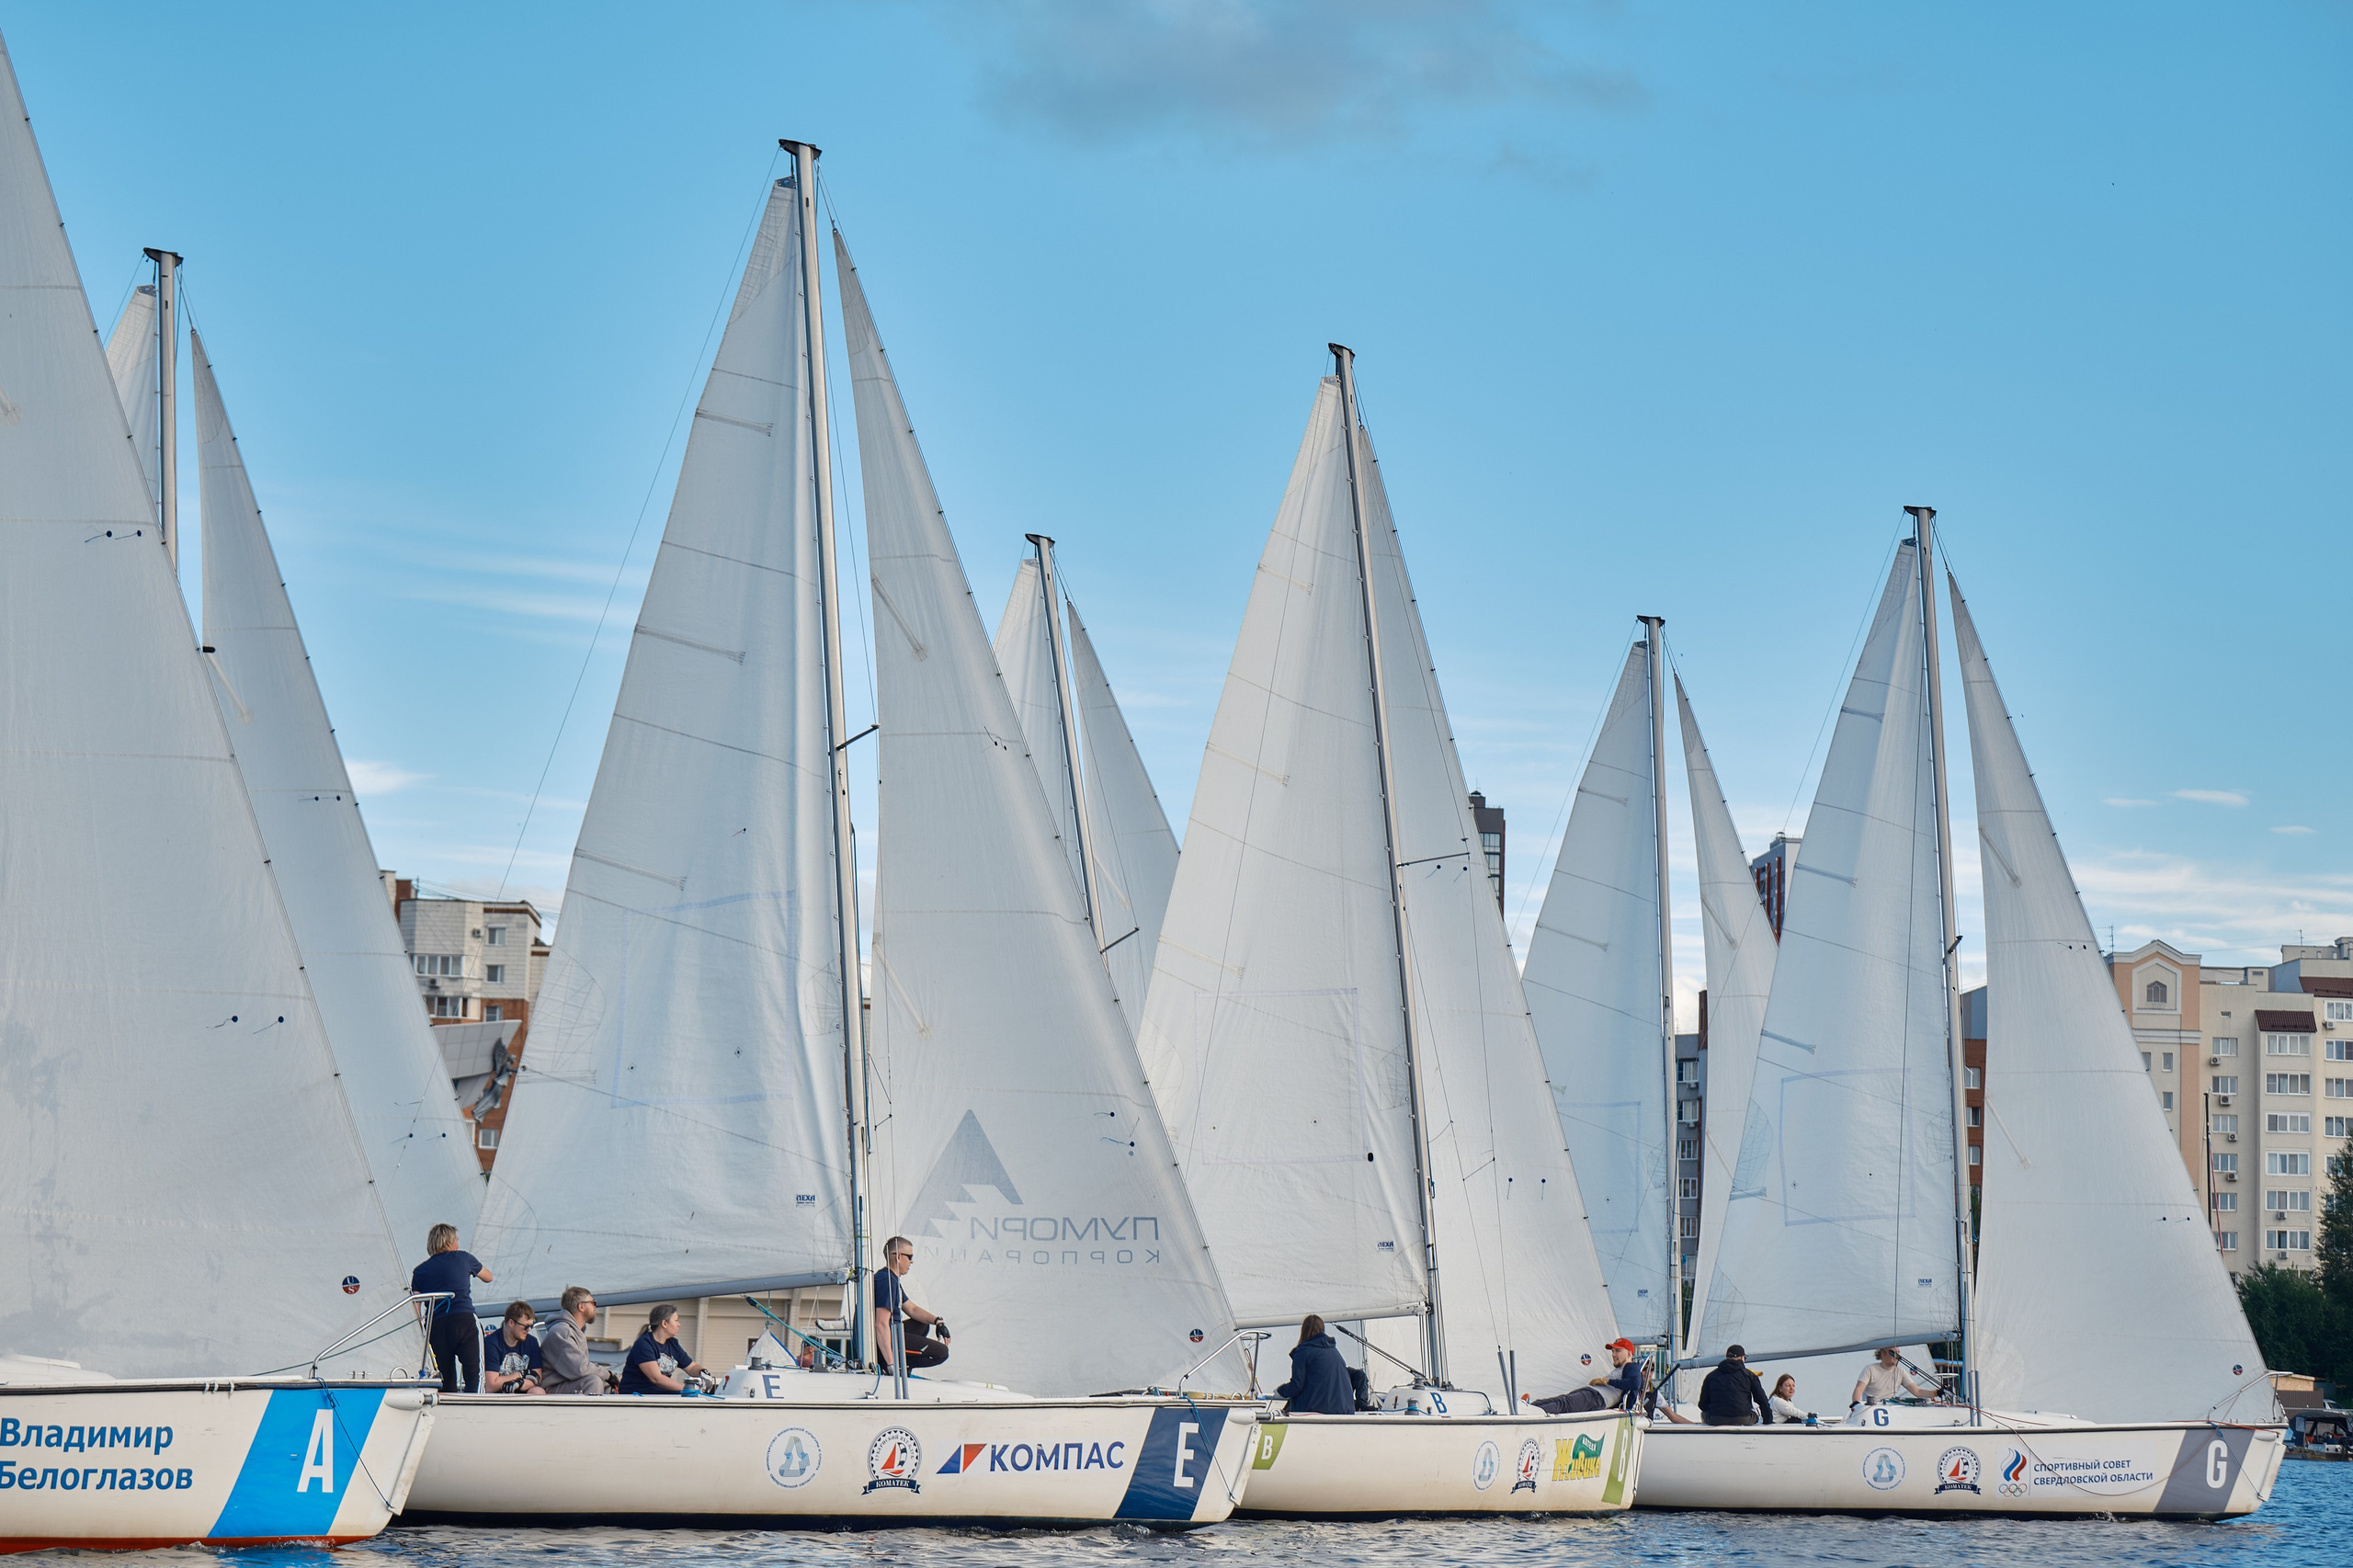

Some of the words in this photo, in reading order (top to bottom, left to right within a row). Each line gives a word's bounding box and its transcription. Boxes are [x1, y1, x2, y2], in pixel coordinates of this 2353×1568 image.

[762, 1375, 784, 1399] E
[1430, 1392, 1447, 1413] B
[1873, 1408, 1889, 1426] G
[0, 1417, 174, 1455] Владимир
[1261, 1435, 1273, 1460] B
[297, 1409, 334, 1493] A
[990, 1441, 1125, 1471] КОМПАС
[1174, 1422, 1199, 1487] E
[1618, 1429, 1628, 1482] B
[2206, 1439, 2227, 1488] G
[0, 1460, 193, 1490] Белоглазов
[2034, 1460, 2100, 1472] СПОРТИВНЫЙ
[2103, 1460, 2131, 1470] СОВЕТ
[2034, 1472, 2108, 1486] СВЕРДЛОВСКОЙ
[2110, 1472, 2153, 1482] ОБЛАСТИ
[876, 1479, 909, 1488] КОМАТЕК
